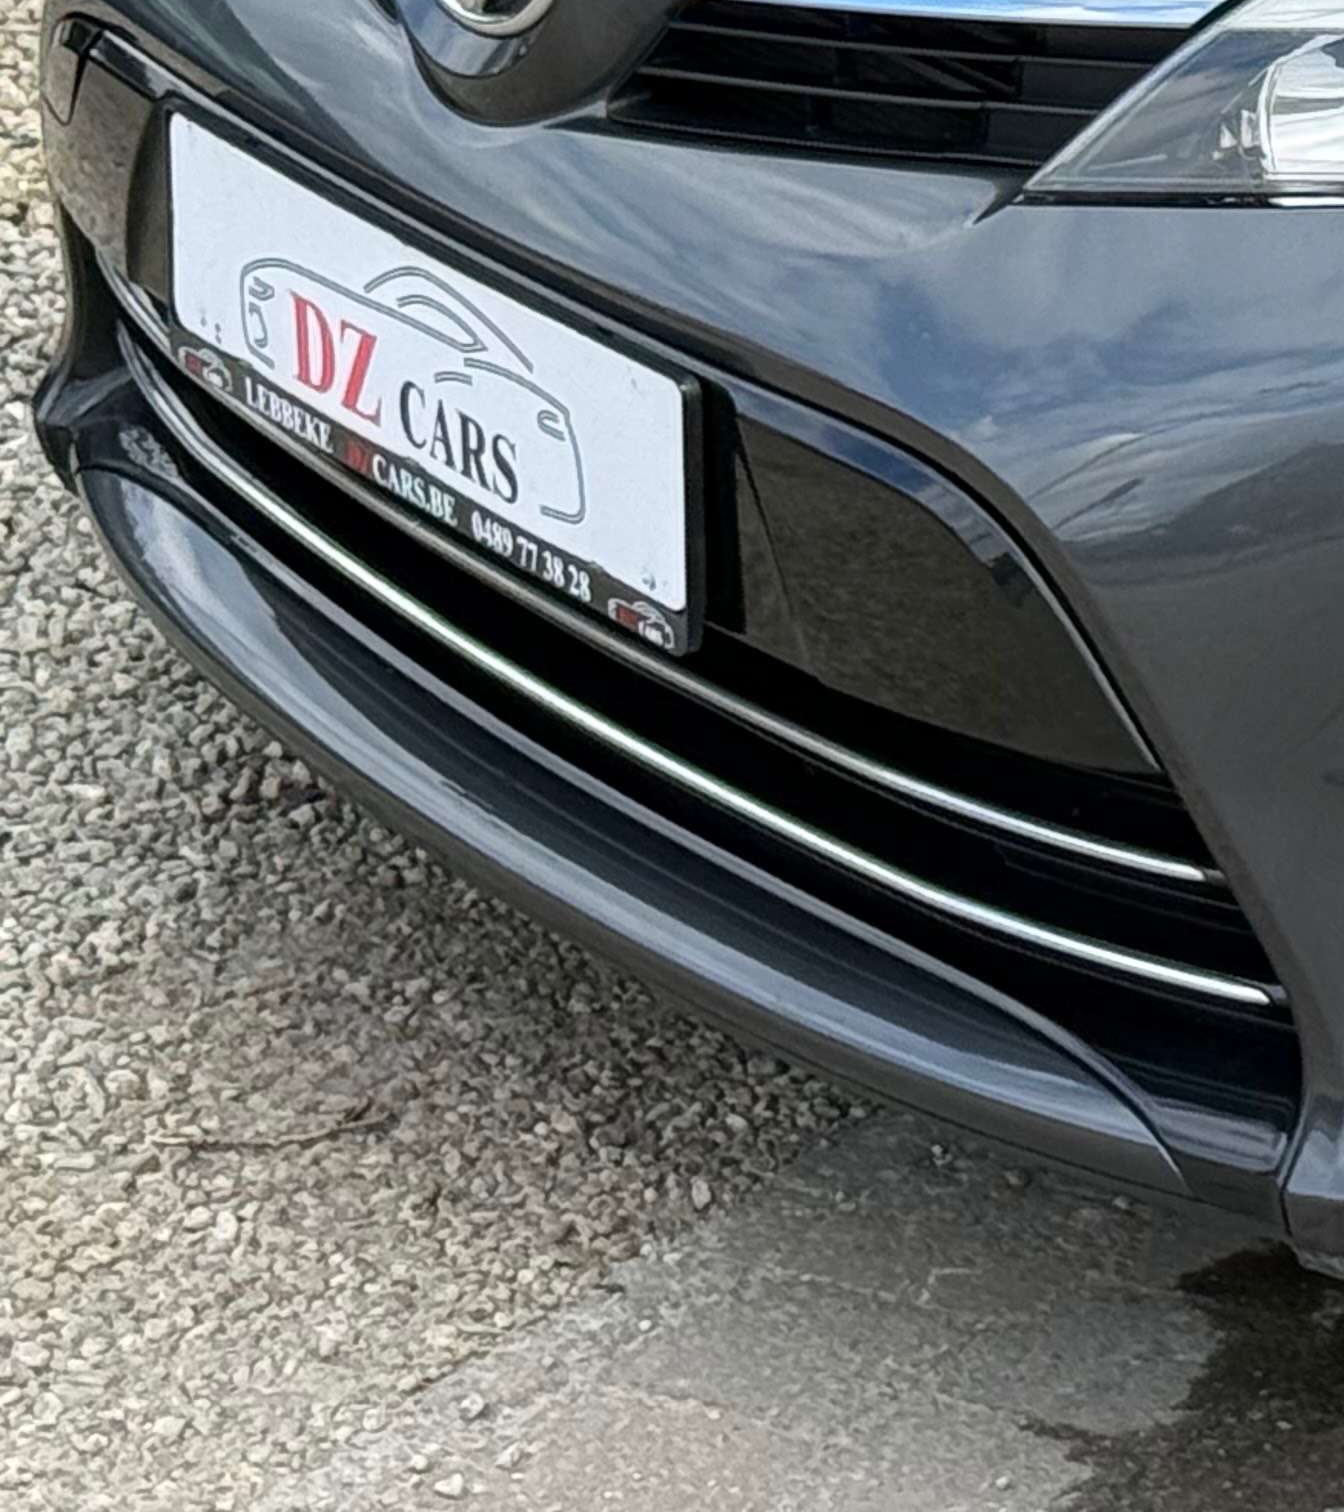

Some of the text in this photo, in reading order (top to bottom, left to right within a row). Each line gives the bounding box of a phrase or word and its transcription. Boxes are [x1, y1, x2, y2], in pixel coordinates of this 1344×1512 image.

[244, 377, 334, 452] LEBBEKE
[471, 510, 513, 557] 0489
[517, 535, 538, 572] 77
[542, 550, 565, 588] 38
[568, 564, 591, 603] 28
[290, 289, 518, 504] DZ CARS
